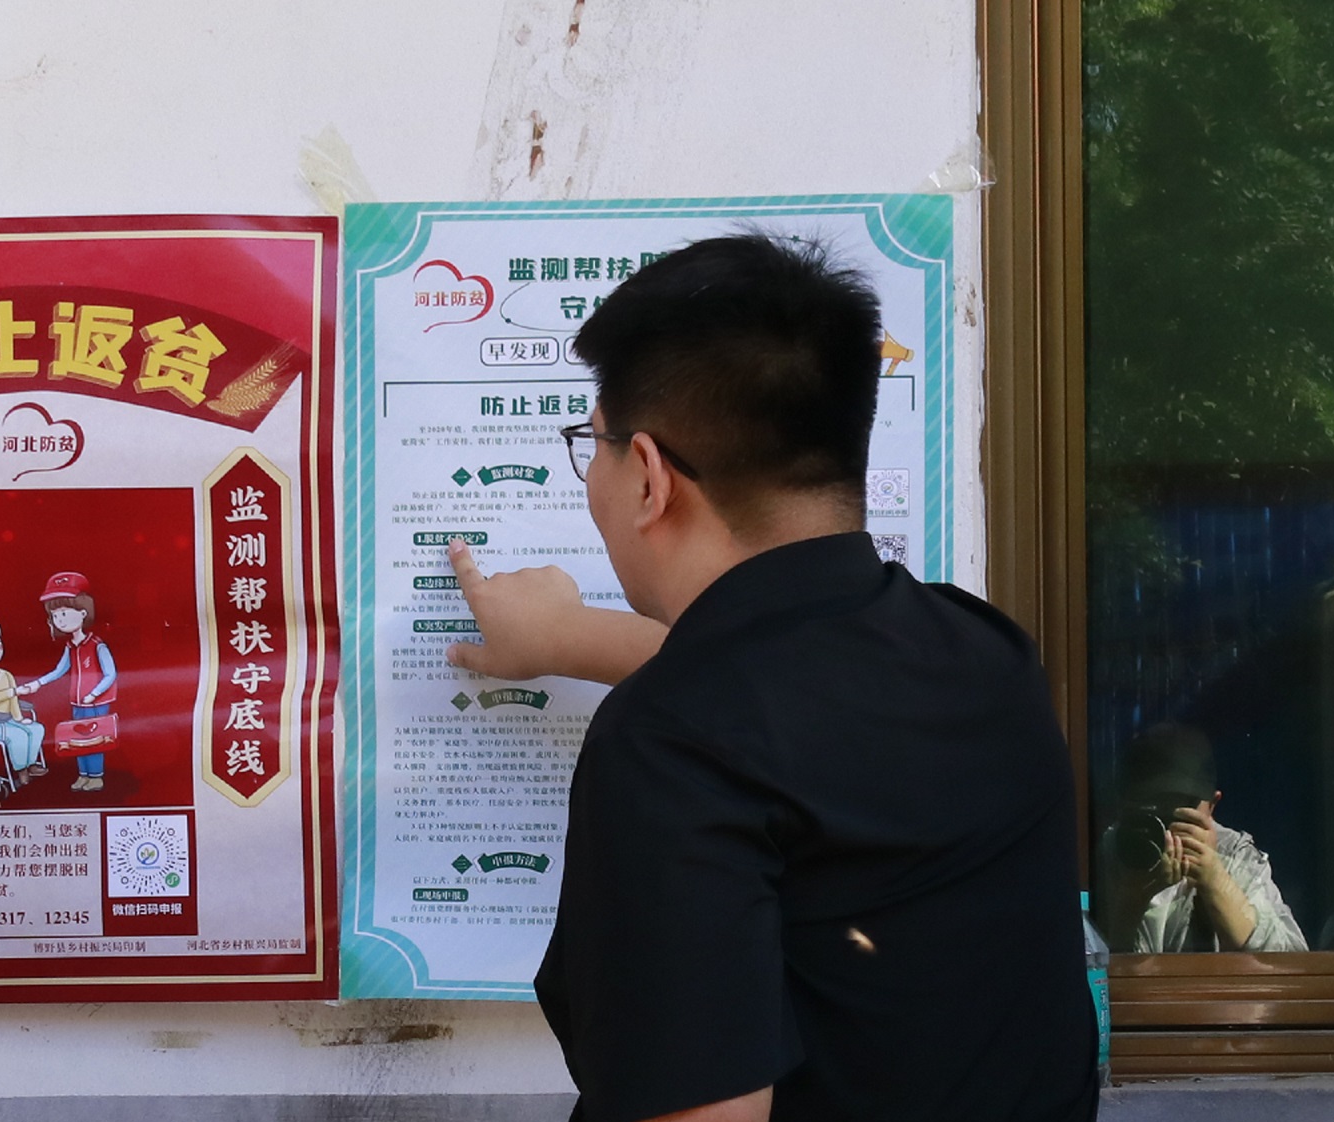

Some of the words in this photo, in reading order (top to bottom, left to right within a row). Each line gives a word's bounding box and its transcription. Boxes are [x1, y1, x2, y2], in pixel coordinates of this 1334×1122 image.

[415, 290, 485, 307] 河北防贫
[560, 296, 607, 319] 守
[488, 342, 551, 360] 早发现
[2, 435, 75, 453] 河北防贫
[490, 466, 535, 480] 监测对象
[224, 485, 274, 778] 监测帮扶守底线
[112, 903, 182, 916] 微信扫码申报
[33, 942, 146, 953] 博野县乡村振兴局印制
[186, 939, 302, 950] 河北省乡村振兴局监制
